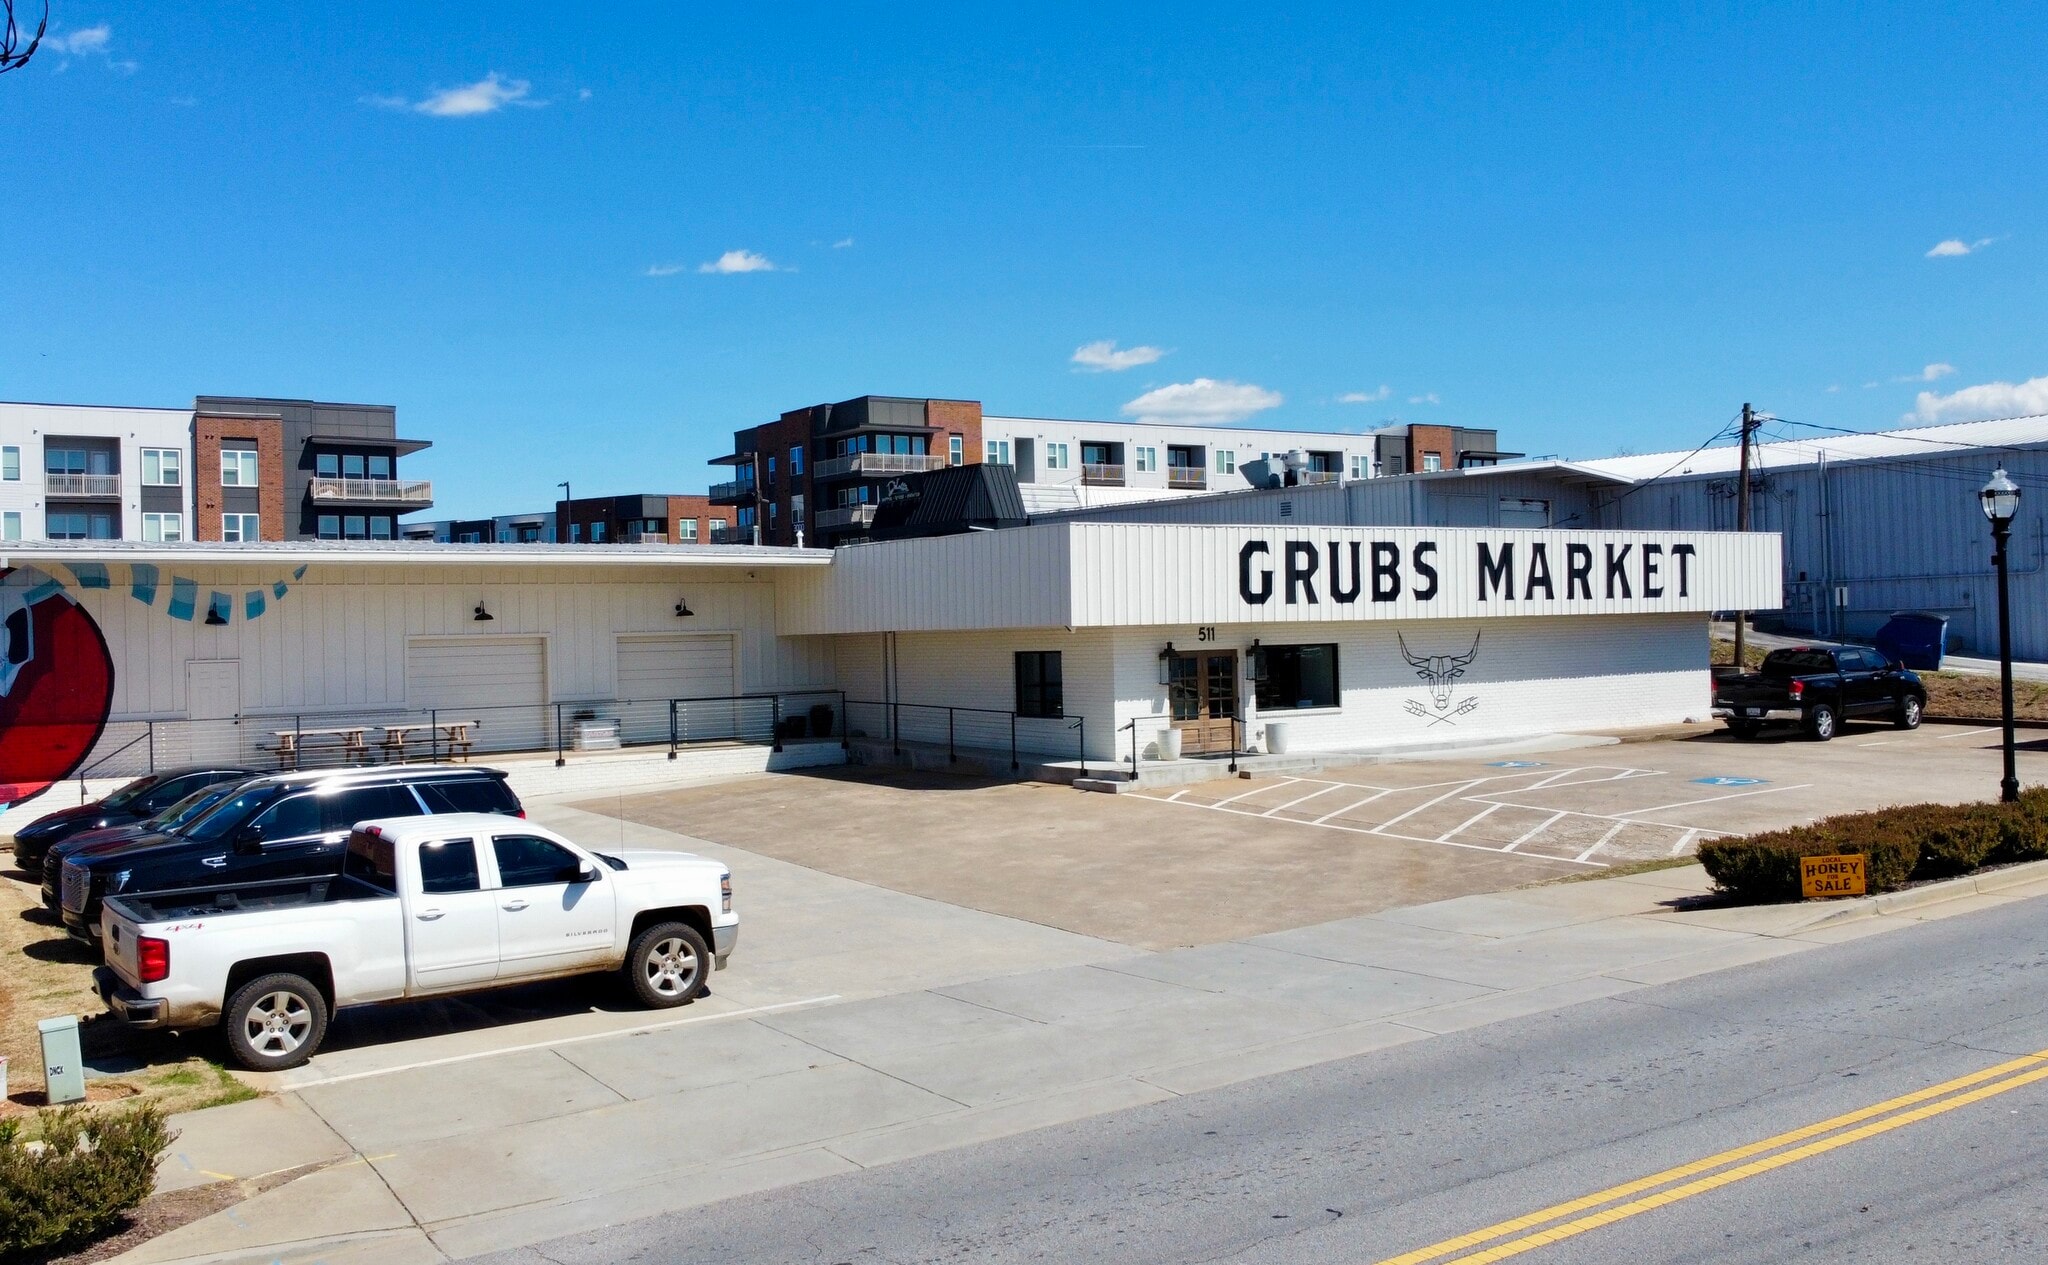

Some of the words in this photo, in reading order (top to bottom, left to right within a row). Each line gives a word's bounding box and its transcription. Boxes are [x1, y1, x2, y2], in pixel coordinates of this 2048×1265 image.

[1239, 540, 1438, 605] GRUBS
[1477, 542, 1696, 601] MARKET
[1198, 626, 1215, 642] 511
[1805, 862, 1859, 878] HONEY
[1815, 877, 1851, 892] SALE
[565, 928, 609, 937] SILVERADO
